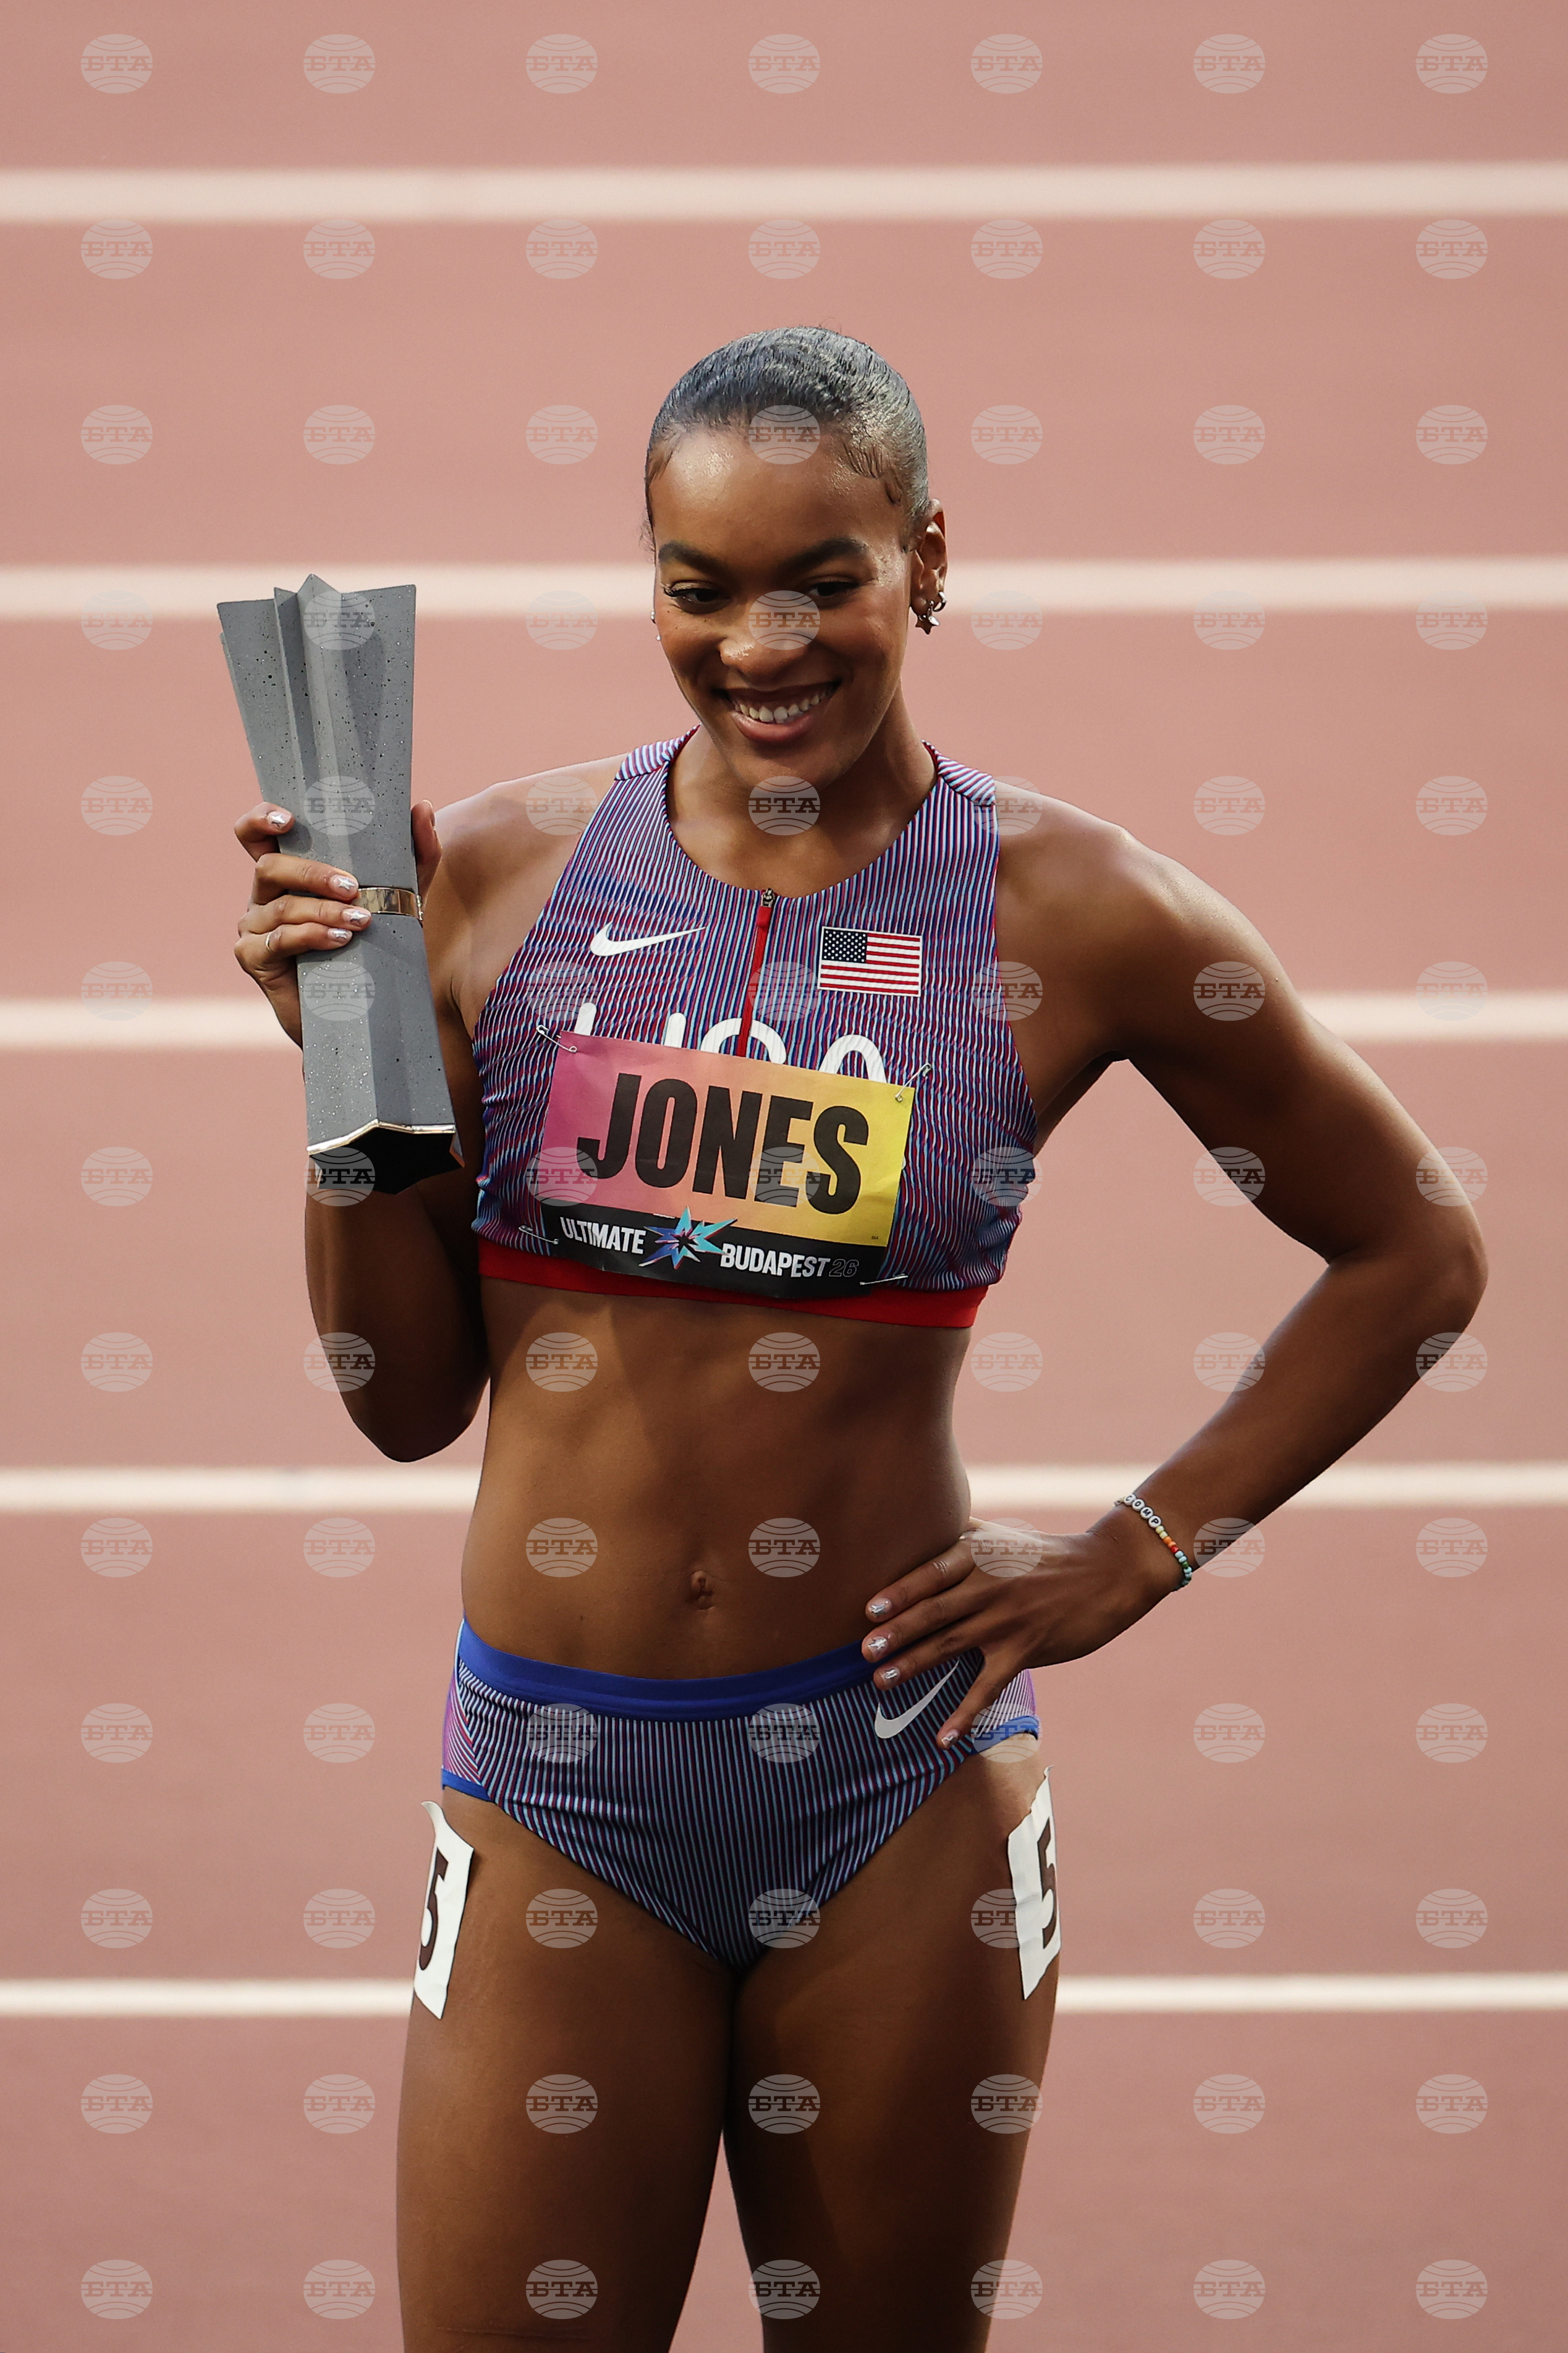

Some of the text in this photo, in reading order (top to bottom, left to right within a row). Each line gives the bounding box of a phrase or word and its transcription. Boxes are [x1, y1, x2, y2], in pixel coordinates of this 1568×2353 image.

[577, 1073, 869, 1215] JONES
[559, 1216, 859, 1279] ULTIMATE BUDAPEST 26
[1125, 1495, 1159, 1525] COMP
[419, 1845, 449, 1972] 5
[1036, 1816, 1057, 1950] 5
